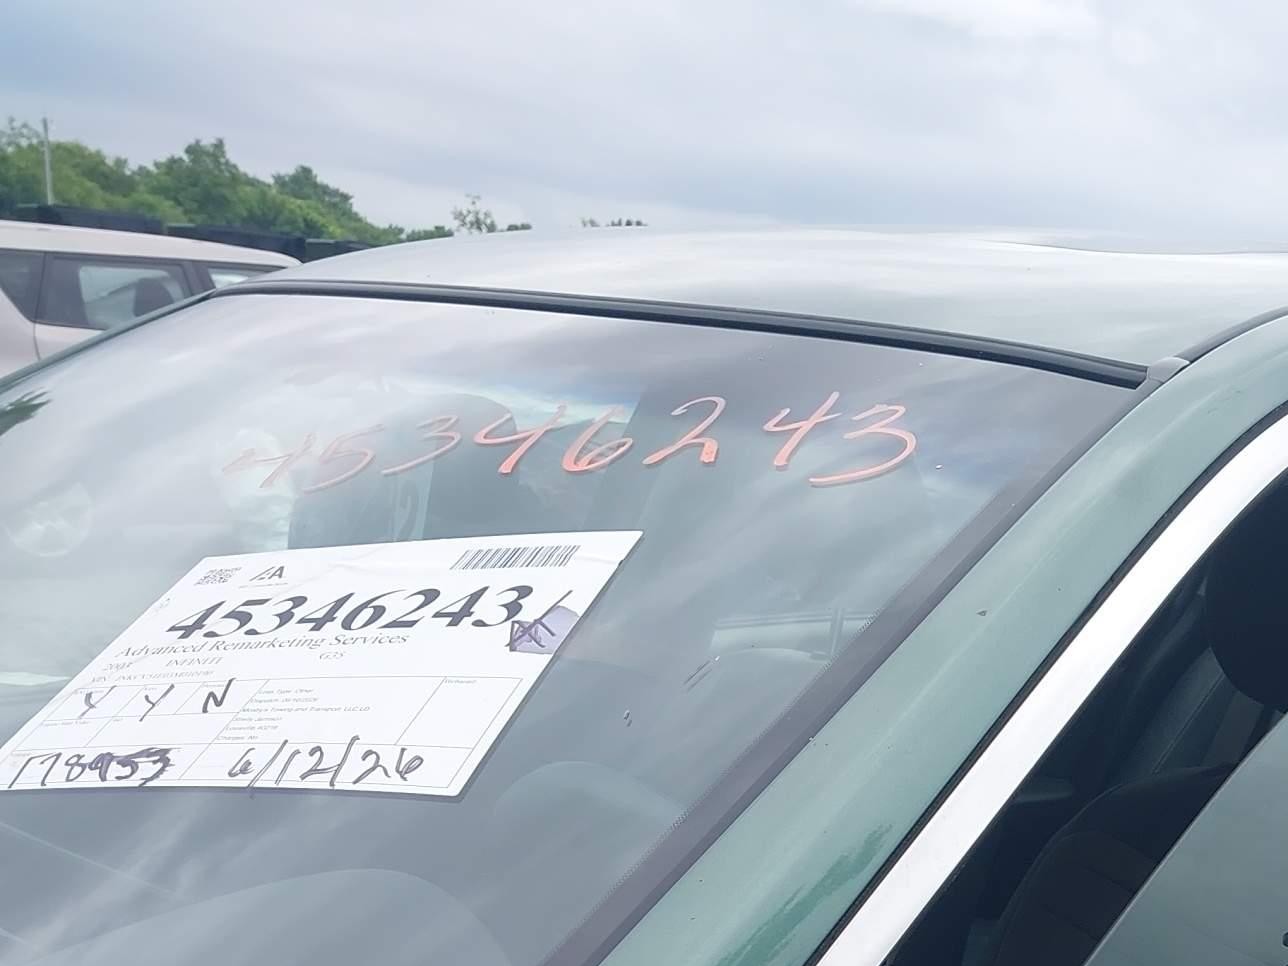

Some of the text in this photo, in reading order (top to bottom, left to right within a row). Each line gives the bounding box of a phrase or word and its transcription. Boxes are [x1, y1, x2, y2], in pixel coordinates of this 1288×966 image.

[222, 391, 916, 494] 45346243
[165, 585, 534, 640] 45346243
[115, 632, 411, 658] Advanced Remarketing Services
[139, 683, 175, 722] Y
[201, 677, 236, 714] N
[227, 735, 424, 790] 6/12/26
